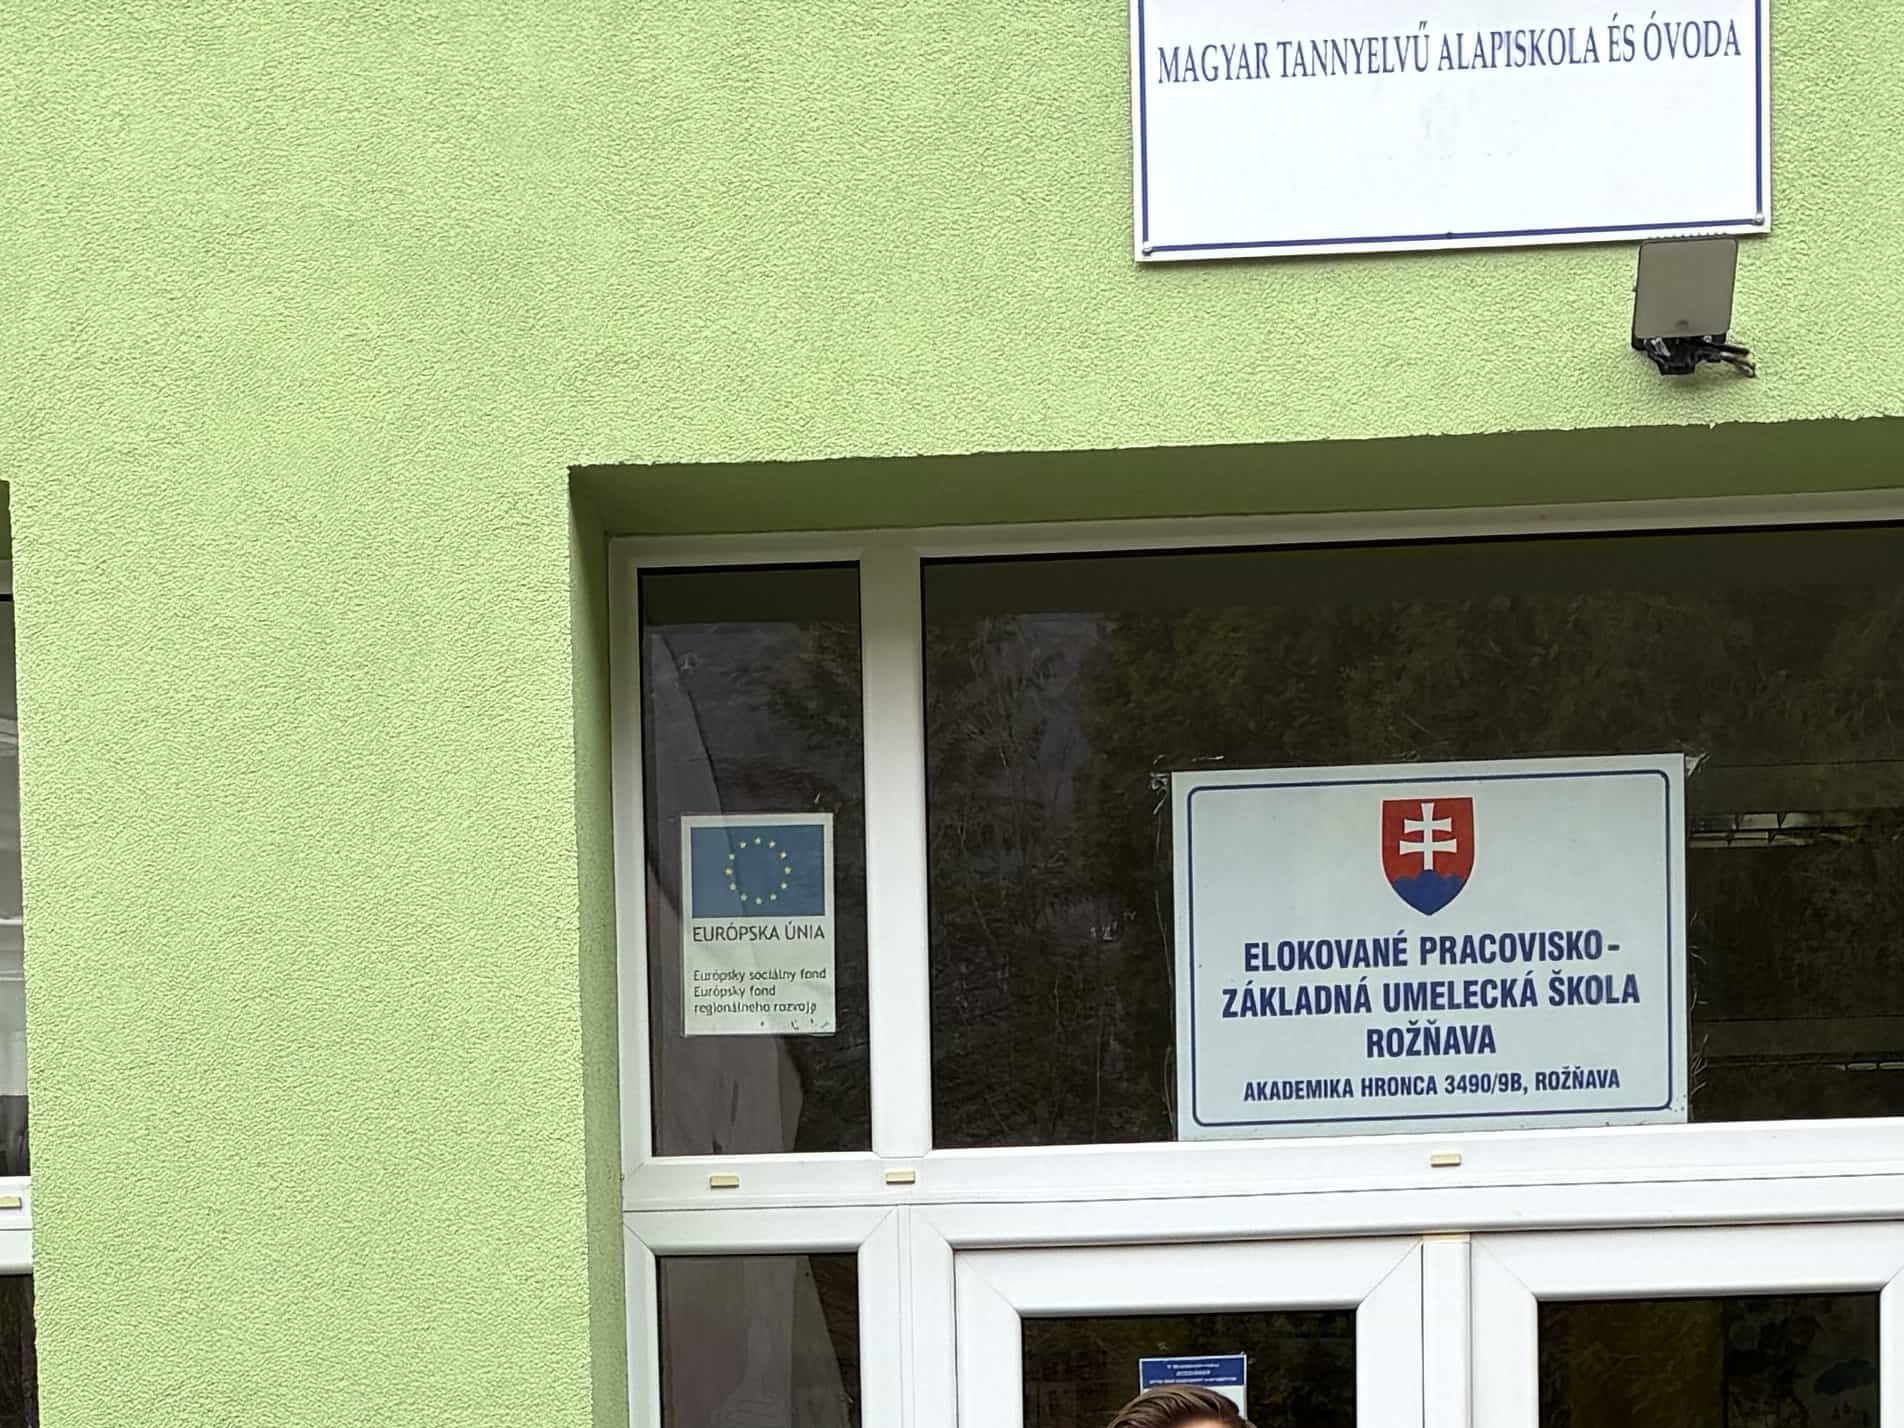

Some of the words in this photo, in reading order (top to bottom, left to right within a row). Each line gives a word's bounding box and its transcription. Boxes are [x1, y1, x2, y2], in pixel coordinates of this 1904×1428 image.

[1157, 44, 1269, 84] MAGYAR
[1276, 20, 1432, 79] TANNYELVŰ
[1437, 26, 1600, 72] ALAPISKOLA
[1607, 13, 1636, 64] ÉS
[1643, 11, 1742, 62] ÓVODA
[692, 921, 780, 942] EURÓPSKA
[784, 920, 825, 941] ÚNIA
[1243, 930, 1408, 973] ELOKOVANÉ
[693, 969, 745, 983] Európsky
[749, 968, 796, 982] sociálny
[800, 967, 827, 980] fond
[693, 985, 745, 998] Európsky
[749, 985, 776, 997] fond
[693, 1002, 771, 1016] regionálneho
[1221, 976, 1373, 1019] ZÁKLADNÁ
[1383, 970, 1539, 1014] UMELECKÁ
[1547, 969, 1641, 1007] ŠKOLA
[1366, 1018, 1497, 1059] ROŽŇAVA
[1243, 1078, 1355, 1102] AKADEMIKA
[1360, 1075, 1438, 1099] HRONCA
[1444, 1071, 1529, 1096] 3490/9B,
[1534, 1065, 1621, 1092] ROŽŇAVA
